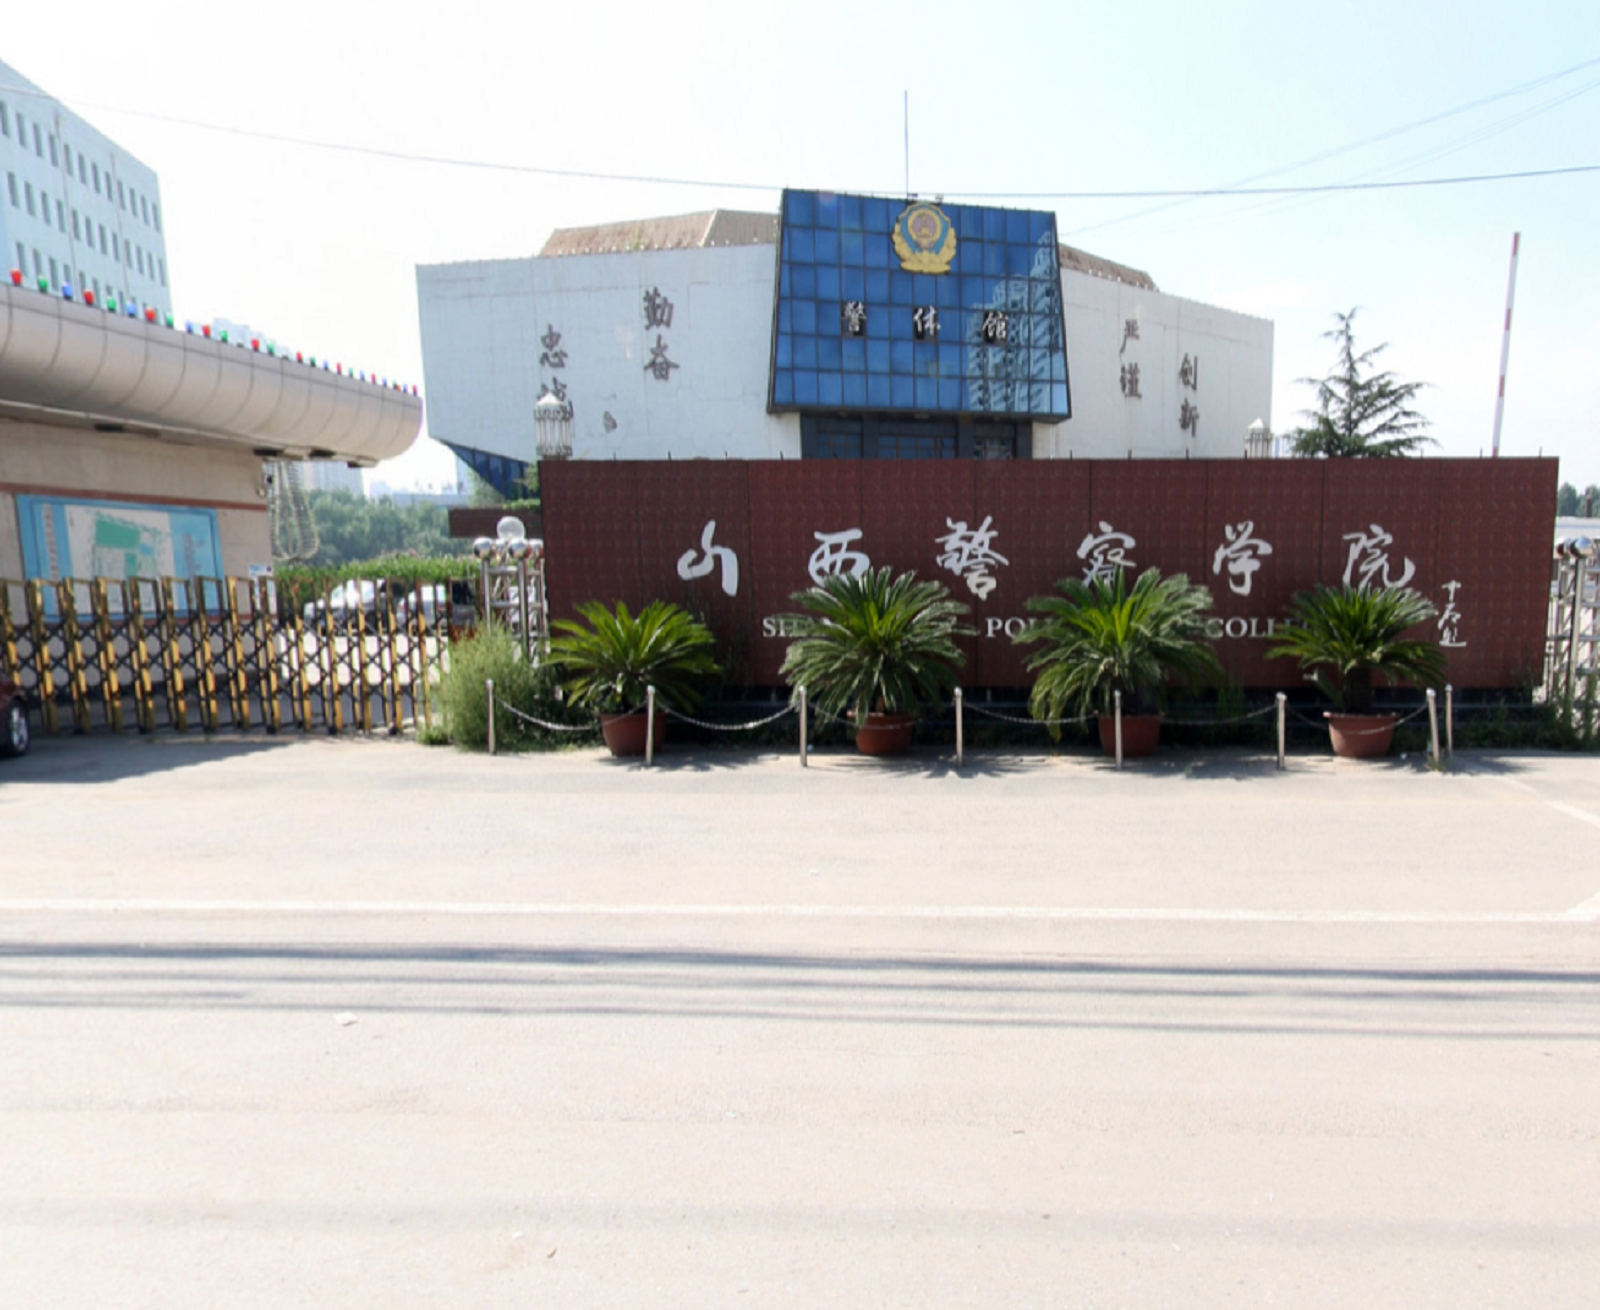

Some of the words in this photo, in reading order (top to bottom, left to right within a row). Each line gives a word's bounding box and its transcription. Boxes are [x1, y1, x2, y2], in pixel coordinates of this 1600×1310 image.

[643, 286, 680, 381] 勤奋
[842, 300, 1009, 340] 警体馆
[1178, 352, 1200, 439] 创新
[676, 515, 1416, 601] 山西警察学院
[1205, 616, 1310, 639] COLL
